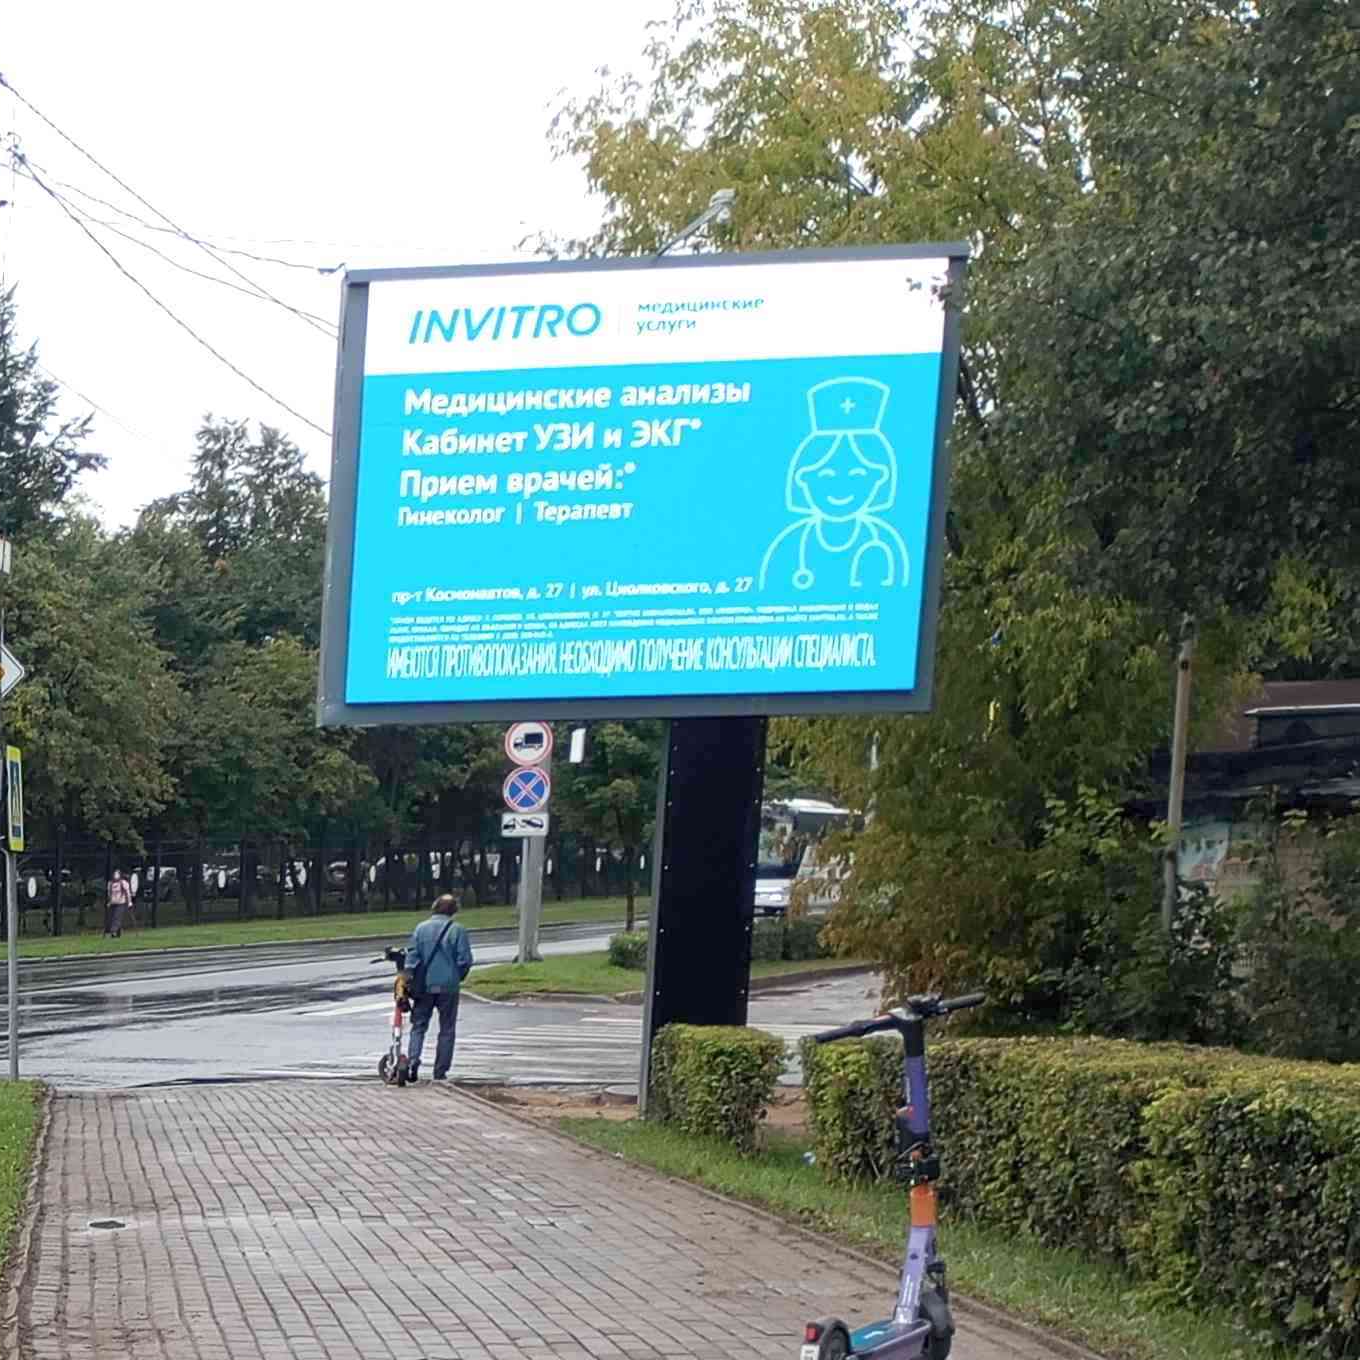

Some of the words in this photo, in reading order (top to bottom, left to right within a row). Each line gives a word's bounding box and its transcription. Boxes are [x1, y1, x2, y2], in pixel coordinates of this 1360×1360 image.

[637, 298, 765, 314] медицинские
[408, 302, 602, 345] INVITRO
[636, 318, 697, 335] услуги
[403, 386, 612, 417] Медицинские
[619, 381, 752, 408] анализы
[401, 427, 529, 456] Кабинет
[532, 420, 596, 452] УЗИ
[602, 427, 624, 449] и
[399, 469, 498, 503] Прием
[397, 506, 506, 527] Гинеколог
[533, 500, 634, 526] Терапевт
[544, 581, 564, 600] 27
[734, 576, 753, 593] 27
